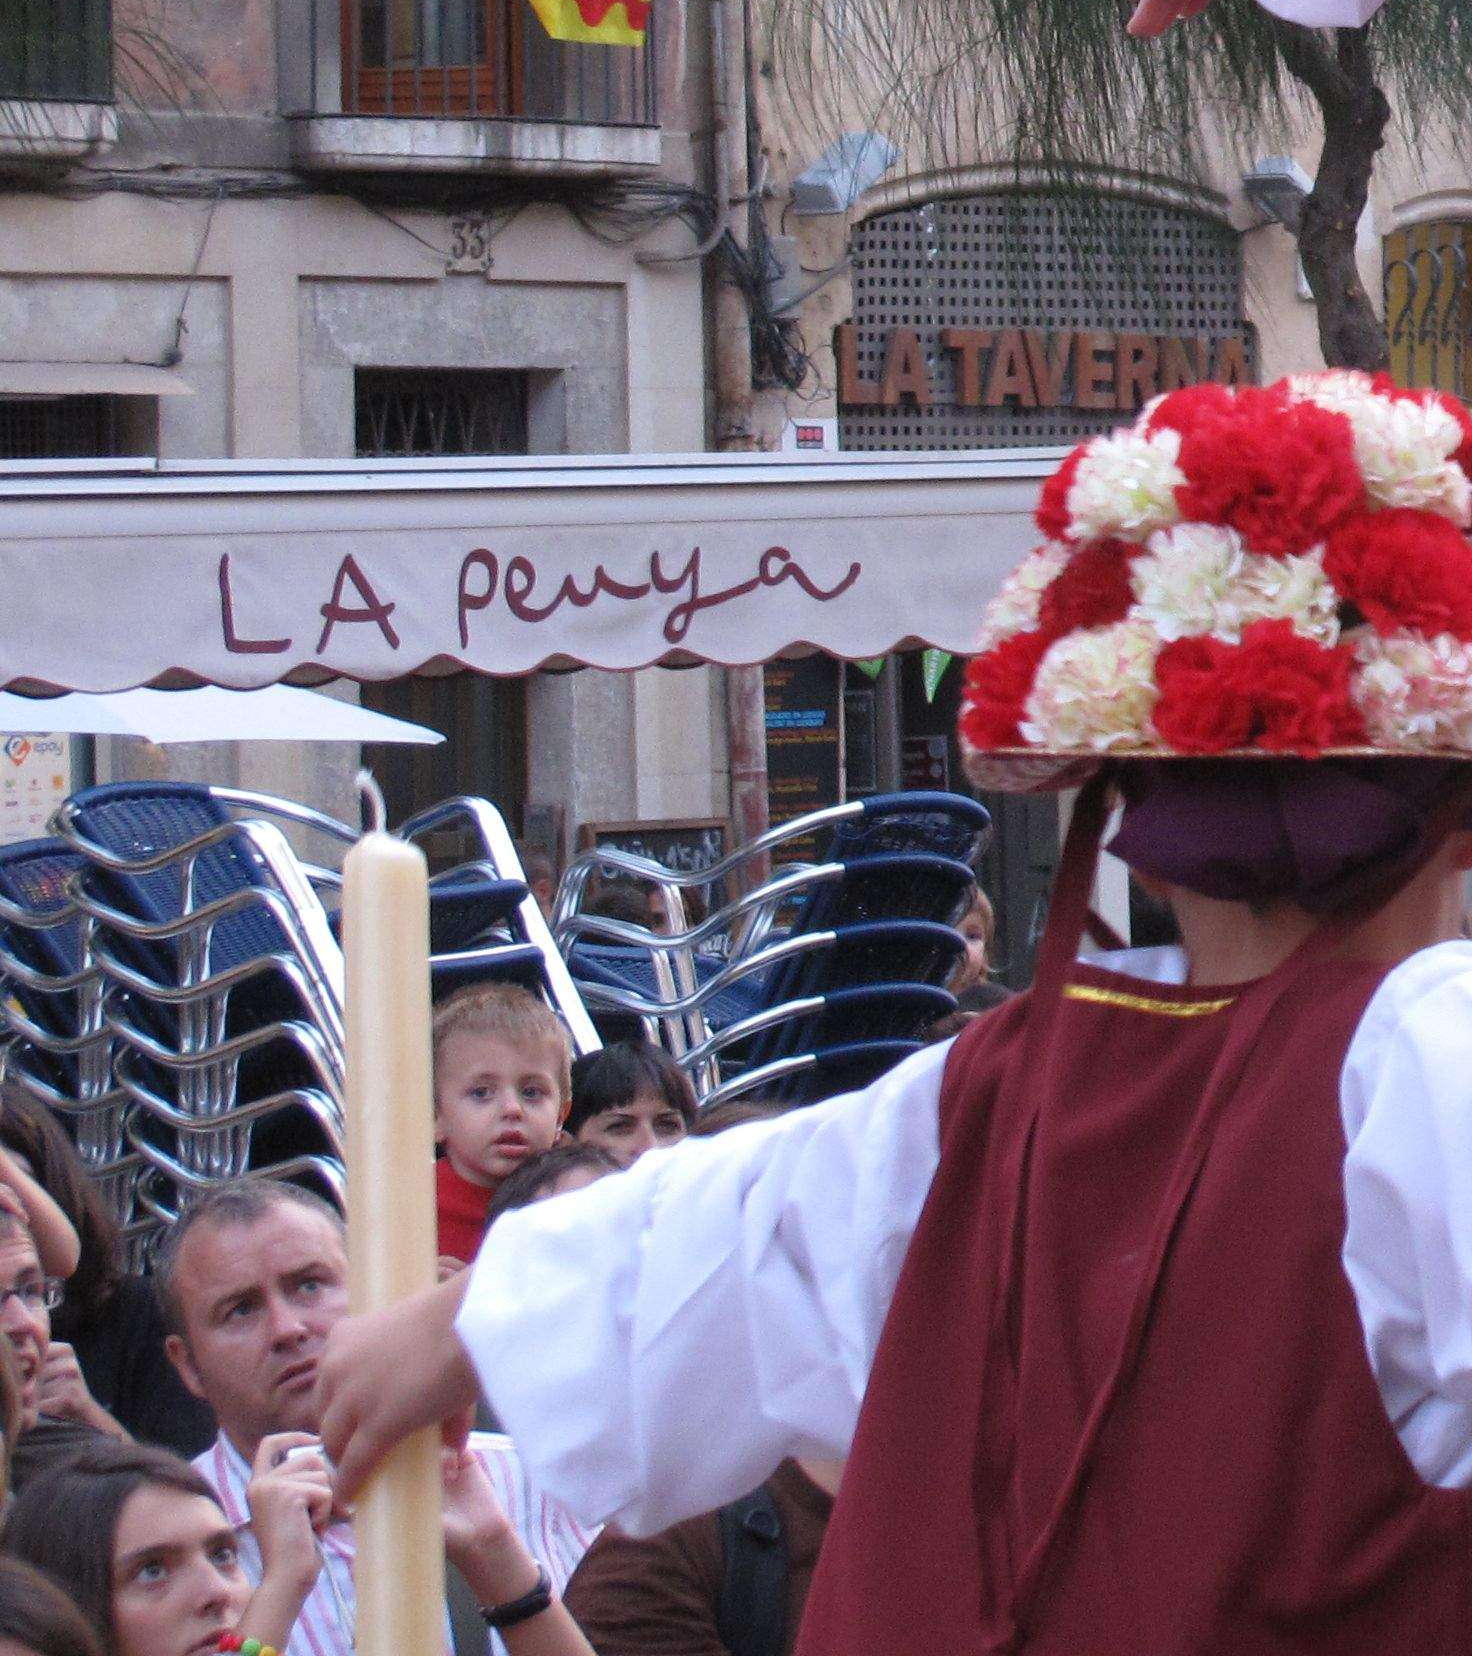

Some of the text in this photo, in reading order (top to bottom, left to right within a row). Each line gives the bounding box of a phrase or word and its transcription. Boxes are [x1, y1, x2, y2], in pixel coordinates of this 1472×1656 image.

[836, 324, 1252, 410] LA TAVERNA
[218, 552, 401, 656] LA
